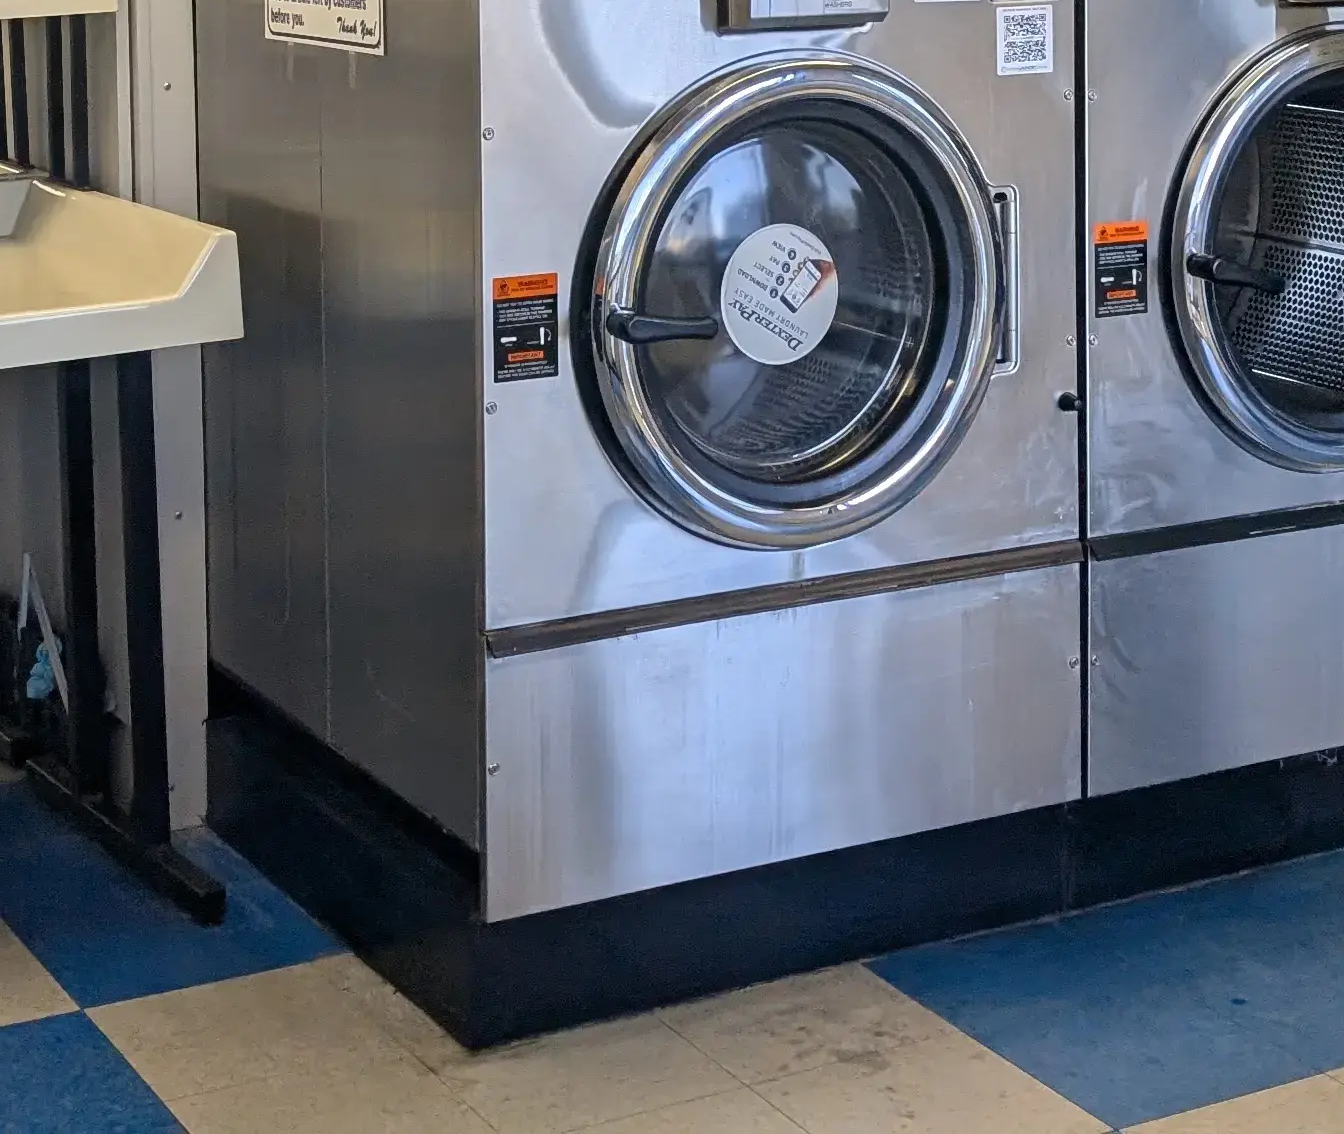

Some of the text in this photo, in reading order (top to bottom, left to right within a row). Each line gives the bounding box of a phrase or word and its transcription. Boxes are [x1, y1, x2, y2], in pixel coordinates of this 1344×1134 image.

[271, 8, 304, 29] before you.
[337, 16, 377, 40] Thank You!
[771, 240, 786, 254] VIEW
[753, 262, 775, 279] SELECT
[769, 256, 780, 266] PAY
[737, 268, 768, 292] DOWNLOAD
[734, 287, 809, 340] LAUNDRY MADE EASY
[728, 298, 804, 352] DEXTERPAY
